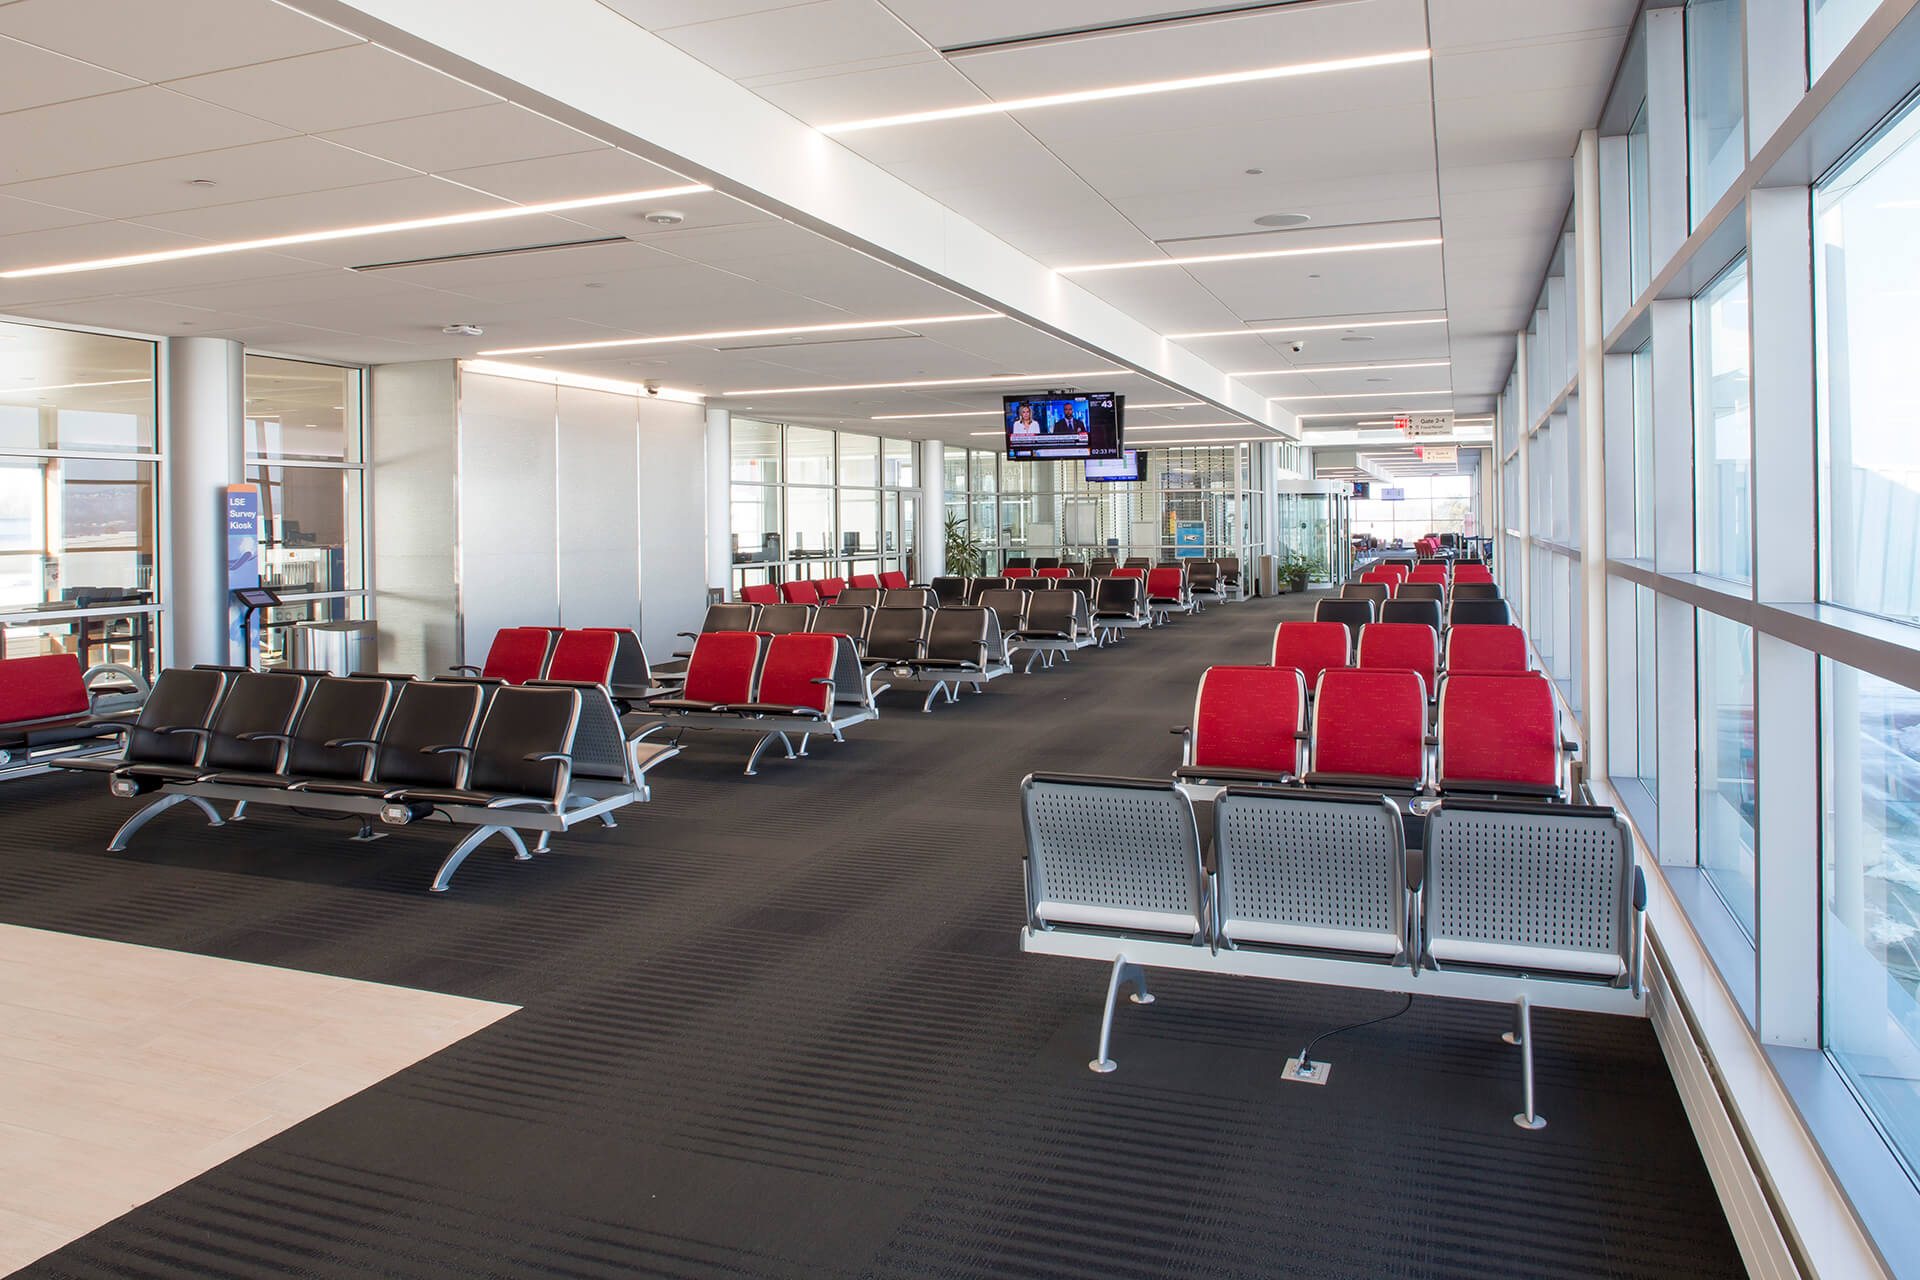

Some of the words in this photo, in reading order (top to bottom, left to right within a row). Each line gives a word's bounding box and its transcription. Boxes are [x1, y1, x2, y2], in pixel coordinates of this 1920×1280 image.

[1101, 400, 1113, 408] 43
[230, 498, 246, 506] LSE
[230, 509, 256, 519] Survey
[230, 521, 252, 529] Kiosk
